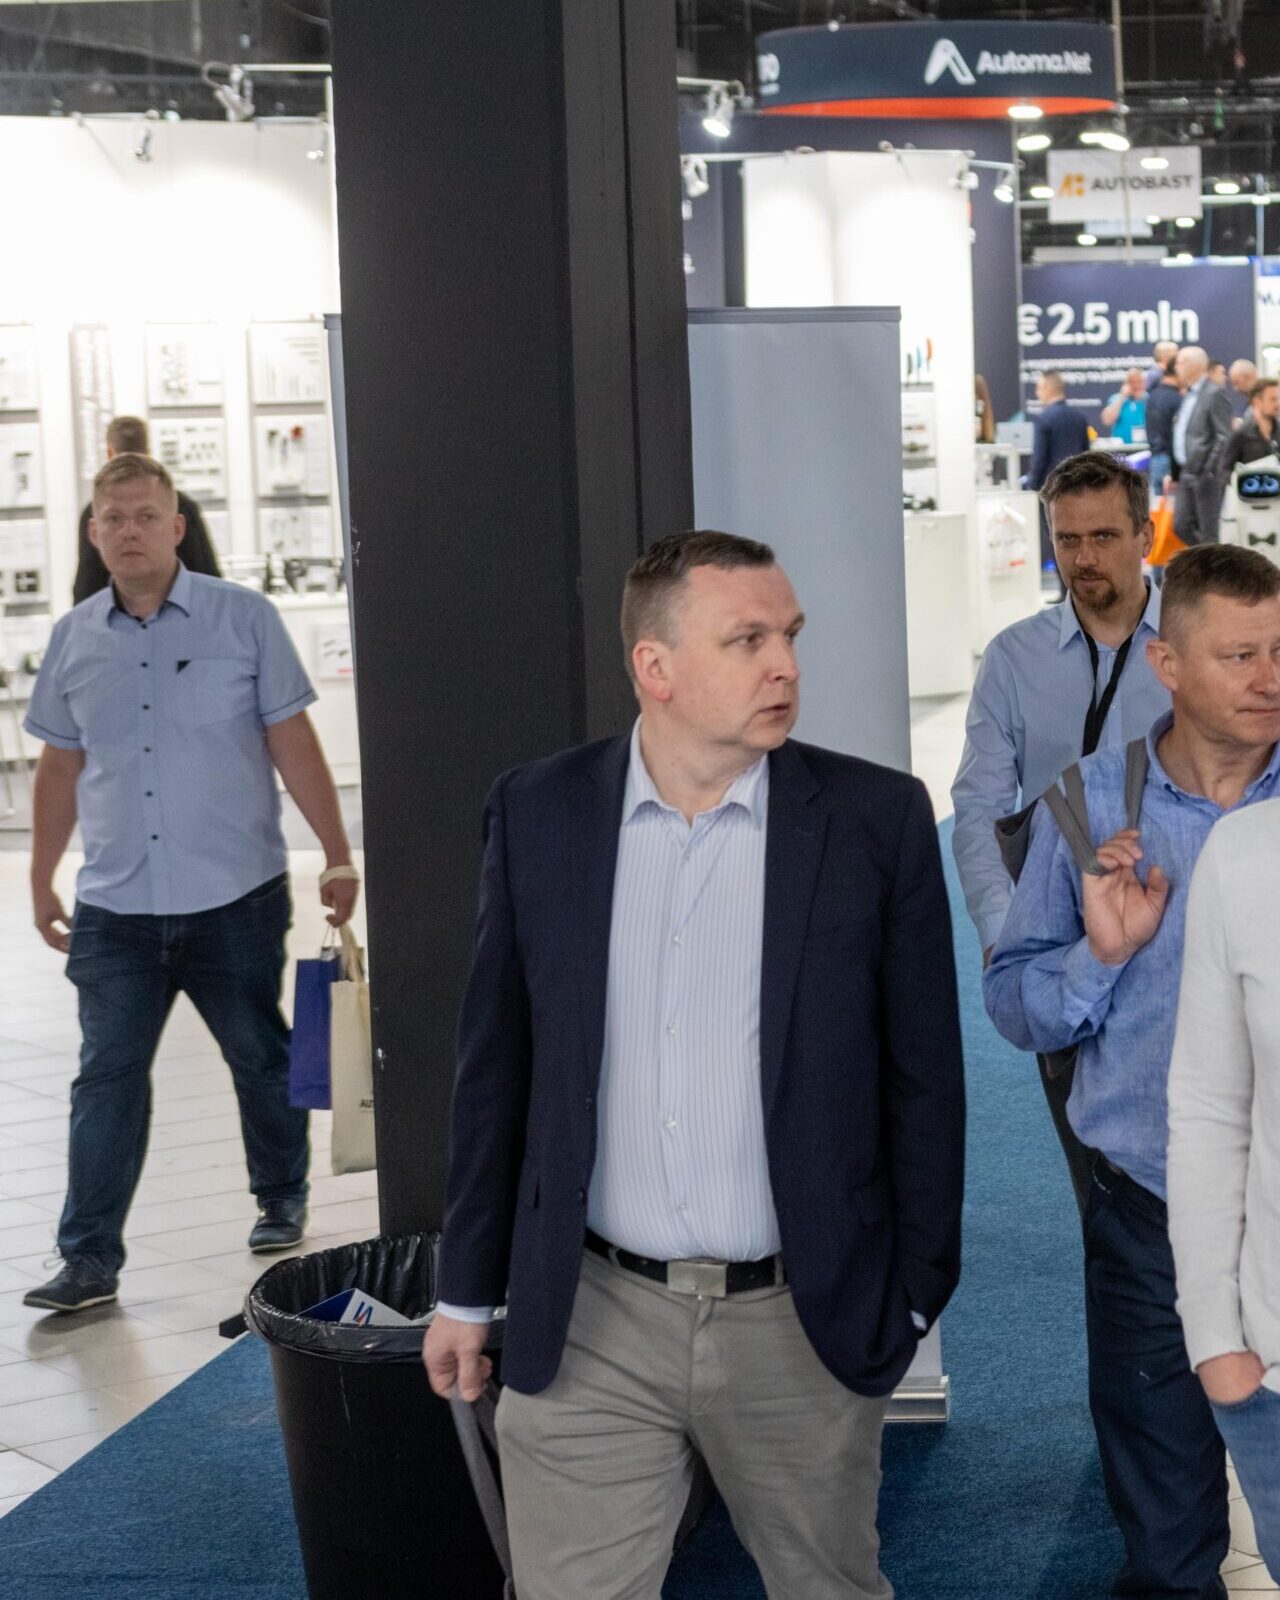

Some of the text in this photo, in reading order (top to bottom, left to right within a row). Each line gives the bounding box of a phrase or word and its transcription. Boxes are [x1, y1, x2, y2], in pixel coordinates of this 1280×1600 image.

[977, 51, 1093, 75] Automa.Net
[1091, 174, 1193, 191] AUTOBAST
[1047, 302, 1112, 346] 2.5
[1117, 300, 1200, 344] mln
